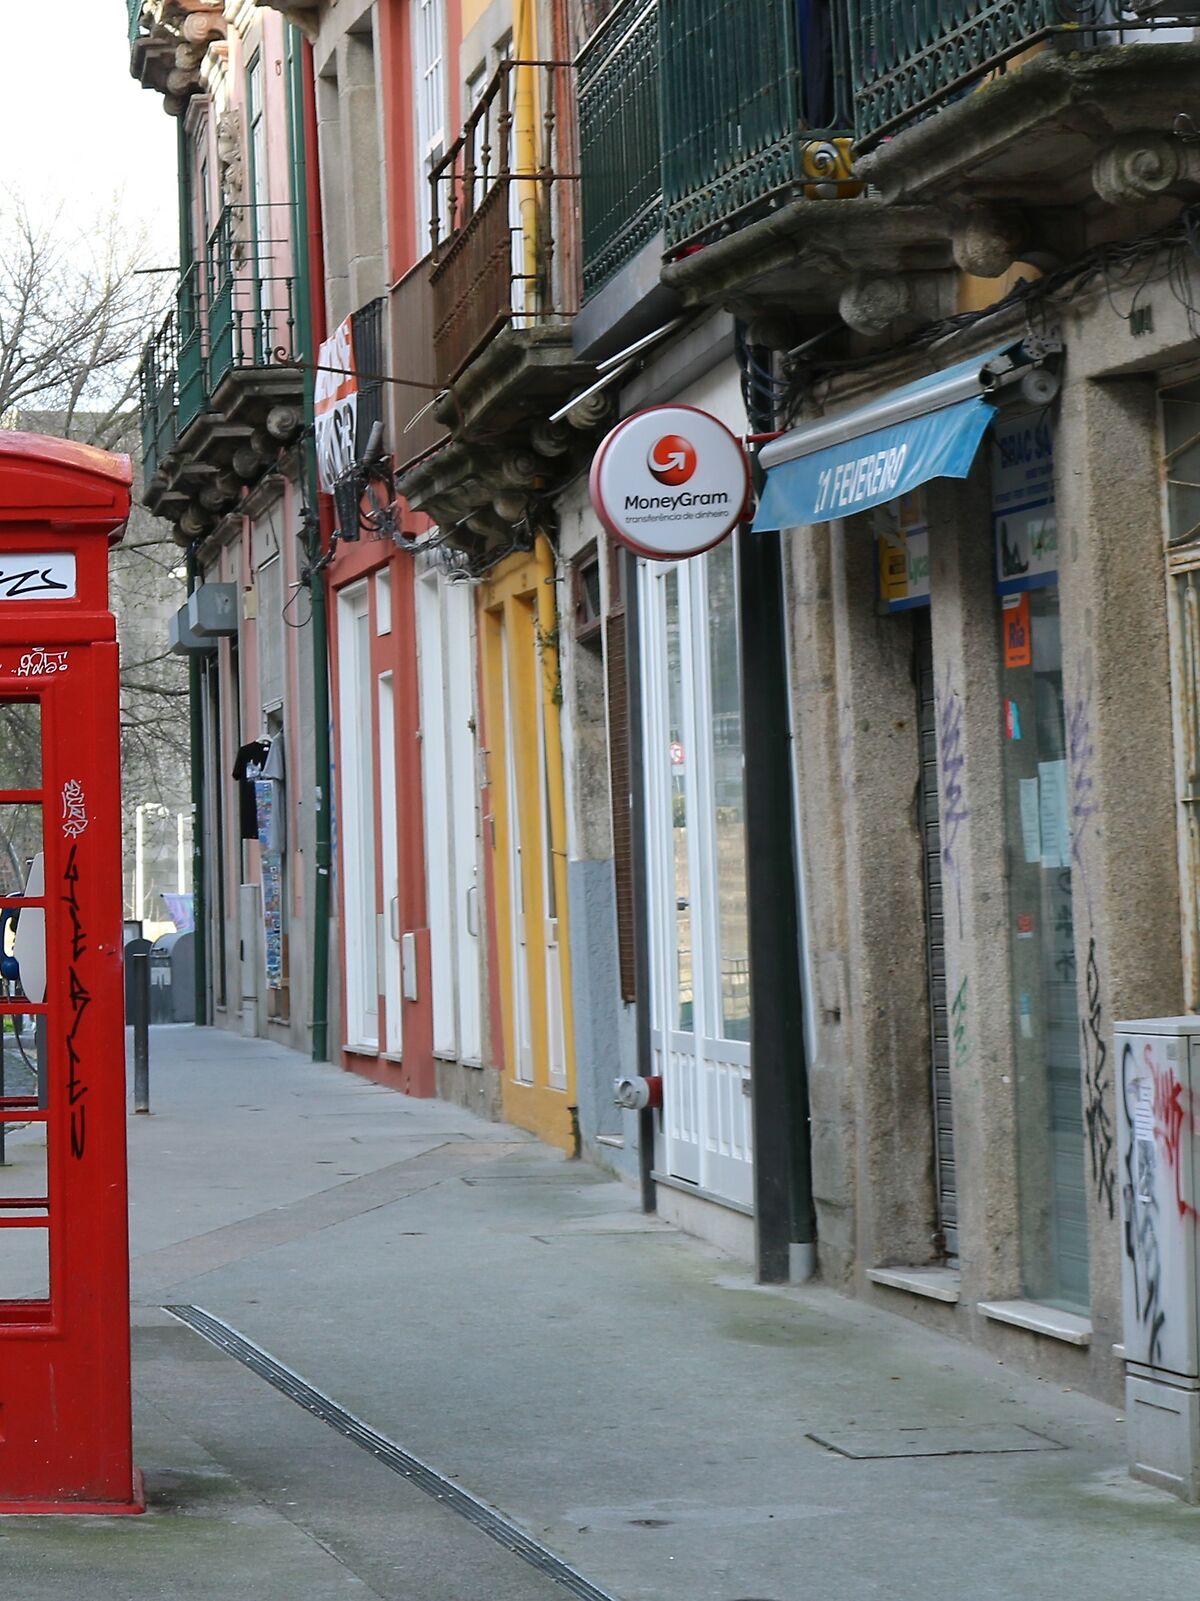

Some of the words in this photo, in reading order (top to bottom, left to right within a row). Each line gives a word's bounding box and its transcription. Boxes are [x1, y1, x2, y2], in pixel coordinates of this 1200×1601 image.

[624, 492, 728, 511] MoneyGram
[625, 512, 682, 524] transferência
[683, 511, 694, 520] de
[695, 509, 729, 520] dinheiro
